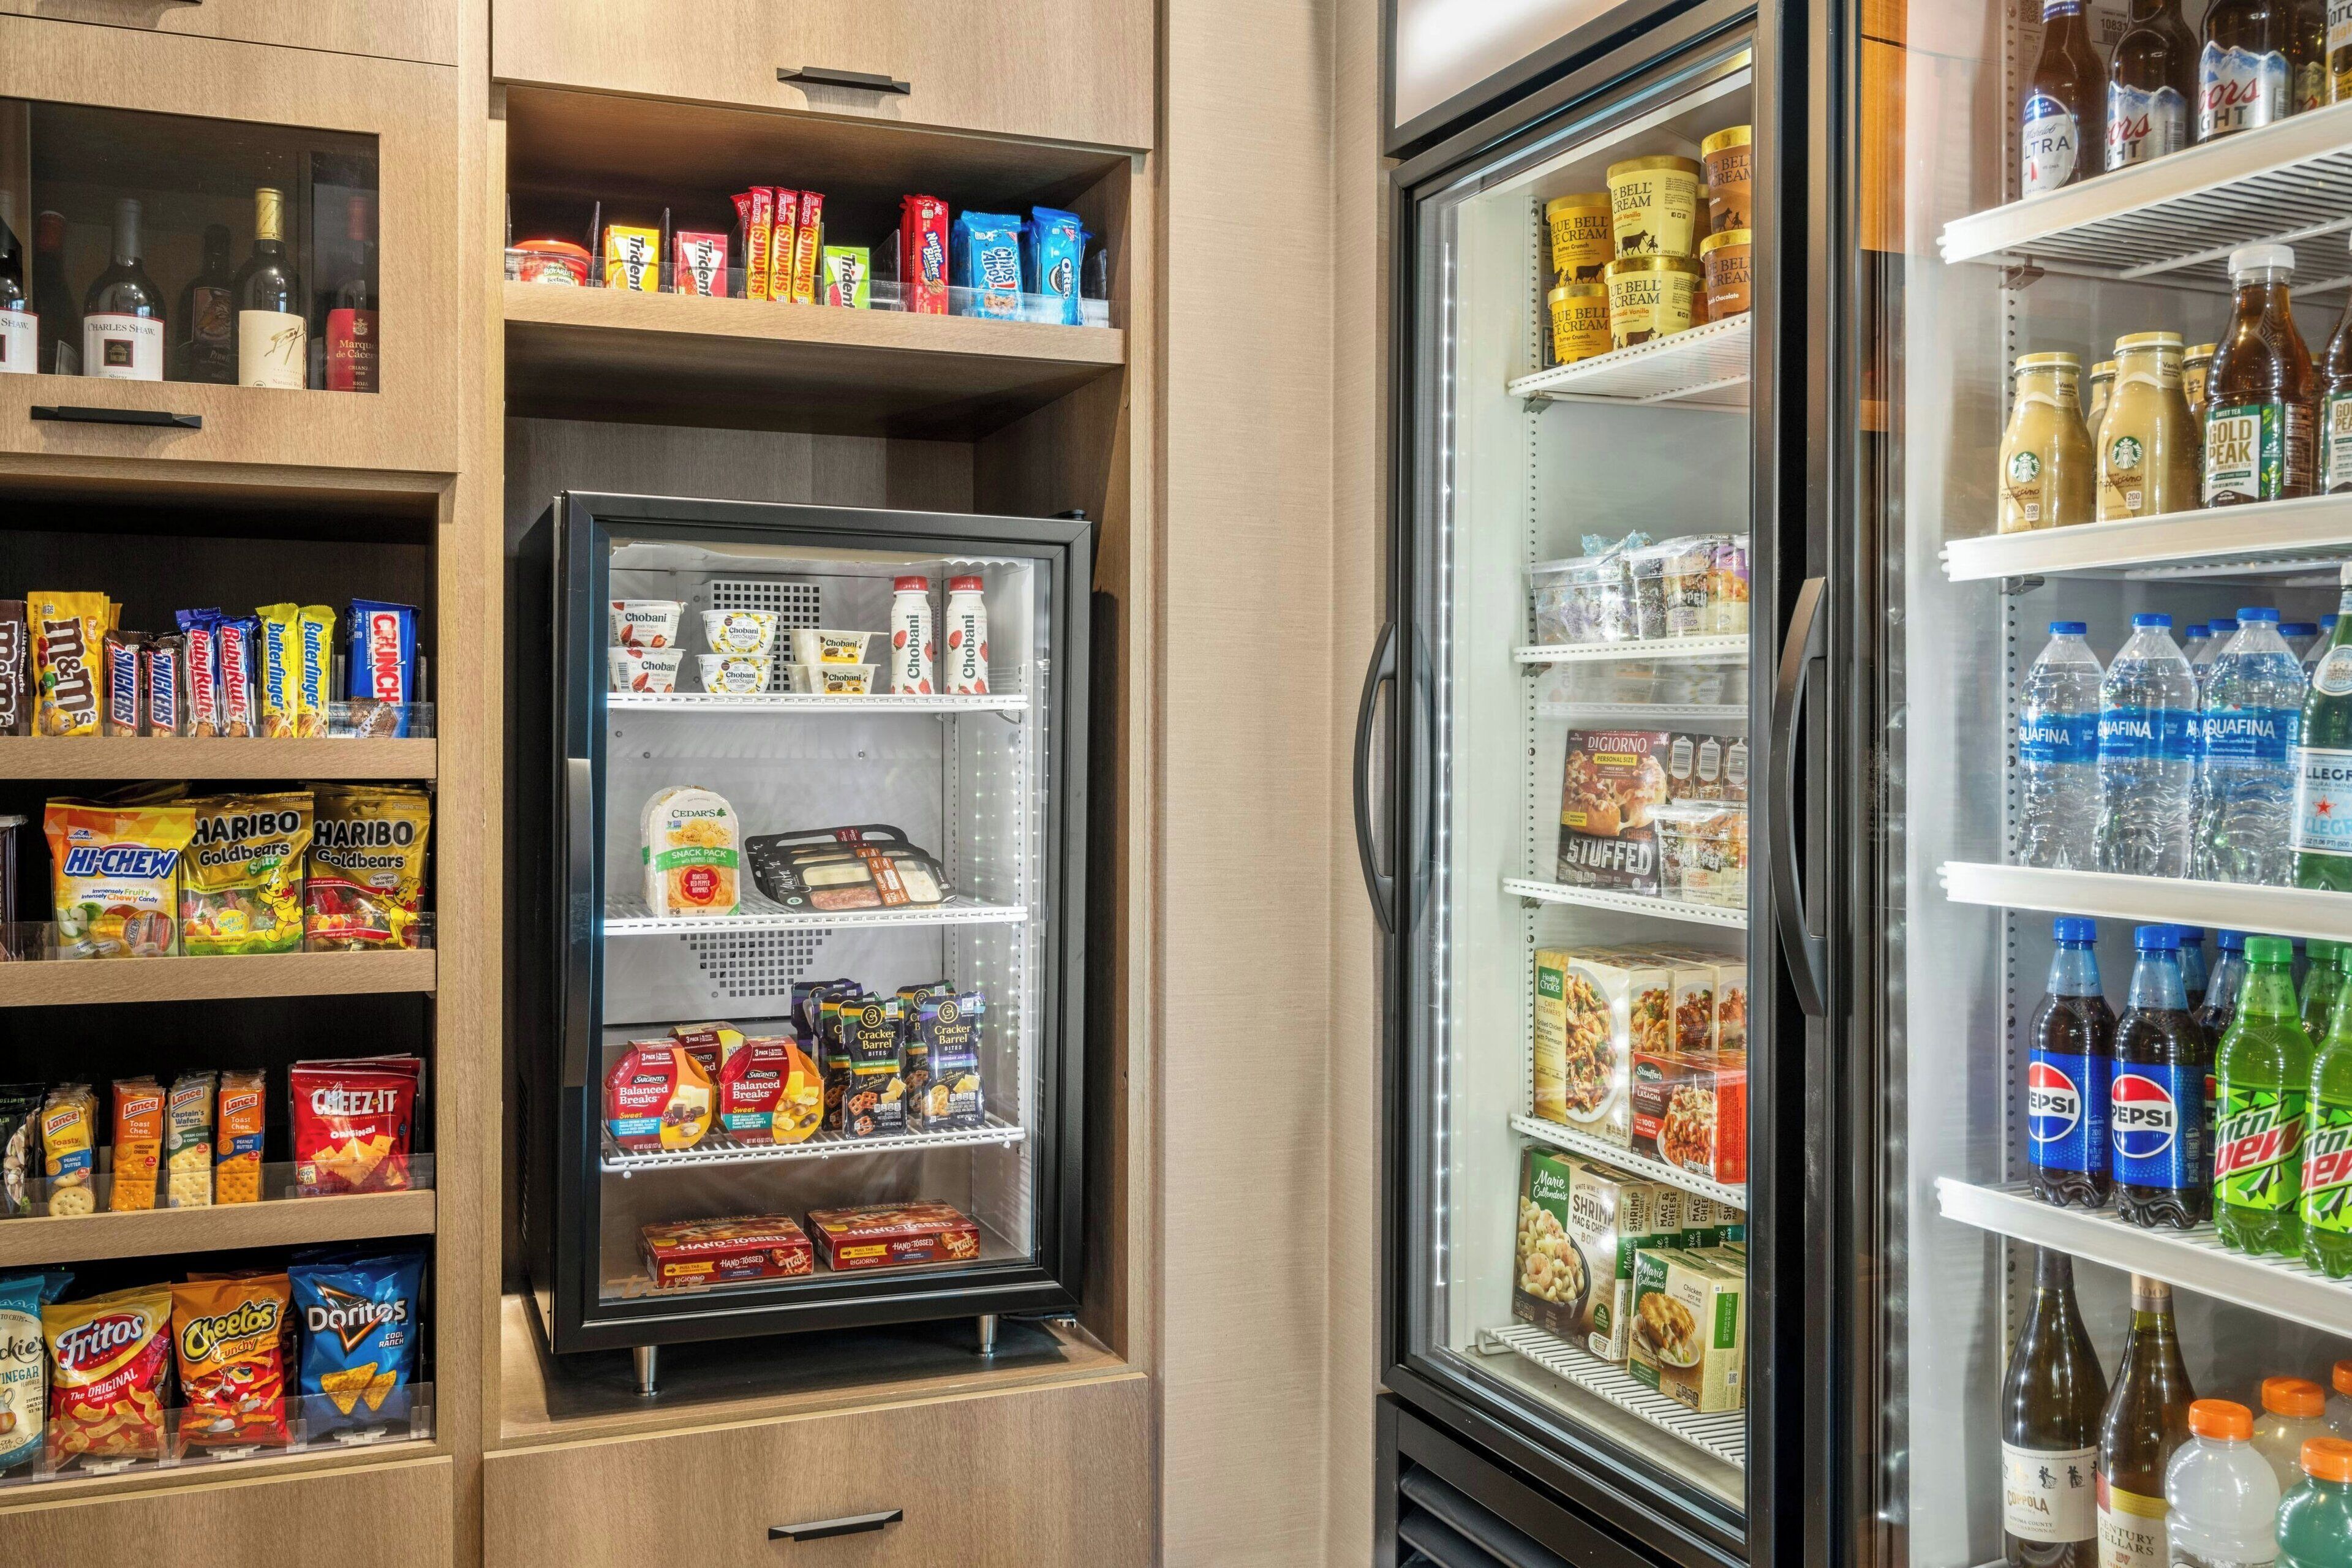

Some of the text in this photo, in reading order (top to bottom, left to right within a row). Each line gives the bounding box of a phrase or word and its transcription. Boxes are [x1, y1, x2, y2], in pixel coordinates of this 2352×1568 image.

[2024, 135, 2071, 159] LTRA
[1620, 183, 1652, 198] BELL
[802, 197, 811, 224] Original
[1615, 195, 1652, 214] CREAM
[1574, 216, 1608, 228] BELL
[1623, 211, 1642, 220] Vanilla
[1562, 228, 1608, 243] CREAM
[925, 232, 943, 265] Nutter
[630, 236, 644, 292] Trident
[750, 225, 766, 295] Starburst
[775, 225, 791, 292] Starburst
[796, 227, 815, 294] Starburst
[922, 247, 940, 278] Butter
[993, 247, 1016, 283] Chips
[544, 268, 575, 278] BOYARDEE
[698, 241, 713, 297] Trident
[842, 255, 856, 308] Trident
[1061, 257, 1072, 300] OREO
[1626, 280, 1661, 293] BELL
[1615, 293, 1660, 307] CREAM
[1716, 293, 1740, 302] Chocolate
[1575, 307, 1608, 320] BELL
[88, 323, 127, 332] CHARLES
[1562, 320, 1608, 333] CREAM
[2209, 420, 2252, 444] GOLD
[2209, 441, 2252, 467] PEAK
[2026, 504, 2038, 513] 200
[625, 612, 666, 623] Chobani
[88, 619, 96, 641] PEANUT
[826, 639, 858, 647] Chobani
[907, 614, 919, 679] Chobani
[962, 614, 975, 679] Chobani
[266, 621, 286, 710] Butterfinger
[301, 620, 323, 709] Butterfinger
[372, 613, 401, 703] CRUNCH
[642, 661, 676, 671] Chobani
[112, 651, 136, 725] SNICKERS
[152, 654, 175, 727] SNICKERS
[2019, 725, 2071, 745] QUAFINA
[2098, 720, 2153, 739] QUAFINA
[2202, 718, 2275, 739] AQUAFINA
[671, 809, 716, 818] CEDAR'S
[191, 810, 301, 846] HARIBO
[312, 820, 415, 847] HARIBO
[1627, 830, 1652, 841] CHEESE
[63, 846, 179, 879] HI-CHEW
[199, 842, 292, 867] Goldbears
[316, 850, 405, 869] Goldbears
[671, 849, 701, 859] SNACK
[1566, 837, 1653, 876] STUFFED
[107, 894, 138, 903] Chewy
[1540, 980, 1560, 993] Choice
[1542, 973, 1560, 984] Healthy
[858, 1030, 896, 1040] Cracker
[934, 1025, 971, 1036] Cracker
[1548, 1022, 1563, 1032] Chicken
[862, 1039, 892, 1050] Barrel
[939, 1035, 968, 1044] Barrel
[1545, 1035, 1562, 1046] Parmesan
[1636, 1065, 1663, 1080] Stouffer's
[619, 1085, 668, 1095] Balanced
[733, 1079, 781, 1091] Balanced
[172, 1088, 202, 1106] Lance
[312, 1088, 398, 1116] CHEEZ-IT
[619, 1095, 658, 1105] Breaks
[733, 1090, 770, 1099] Breaks
[1637, 1090, 1661, 1102] LASAGNA
[2029, 1091, 2075, 1114] EPSI
[124, 1099, 156, 1115] Lance
[225, 1096, 255, 1111] Lance
[47, 1111, 78, 1131] Lance
[172, 1110, 205, 1118] Captain's
[1642, 1118, 1656, 1129] 100%
[1533, 1169, 1566, 1189] Marie
[1533, 1185, 1568, 1201] Callender's
[1573, 1194, 1615, 1226] SHRIMP
[1629, 1192, 1640, 1232] SHRIMP
[1660, 1204, 1669, 1227] MAC
[1668, 1191, 1677, 1227] CHEESE
[1692, 1199, 1701, 1222] MAC
[848, 1221, 953, 1236] HAND-TOSSED
[1572, 1213, 1585, 1227] MAC
[675, 1235, 787, 1251] HAND-TOSSED
[892, 1238, 933, 1251] HAND-TOSSED
[720, 1255, 764, 1268] HAND-TOSSED
[1637, 1262, 1664, 1279] Marie
[1637, 1274, 1665, 1289] Callender's
[1683, 1284, 1702, 1297] Chicken
[9, 1314, 26, 1322] CHIPS
[308, 1299, 407, 1332] Doritos
[182, 1300, 277, 1362] Cheetos
[385, 1331, 404, 1340] COOL
[55, 1315, 145, 1370] Fritos
[211, 1336, 258, 1363] Crunchy
[379, 1338, 404, 1348] RANCH
[21, 1379, 40, 1388] FLAVORED
[70, 1368, 138, 1401] The ORIGINAL
[2007, 1489, 2050, 1515] COPPOLA
[2100, 1516, 2155, 1545] CENTURY
[2100, 1527, 2154, 1556] CELLARS
